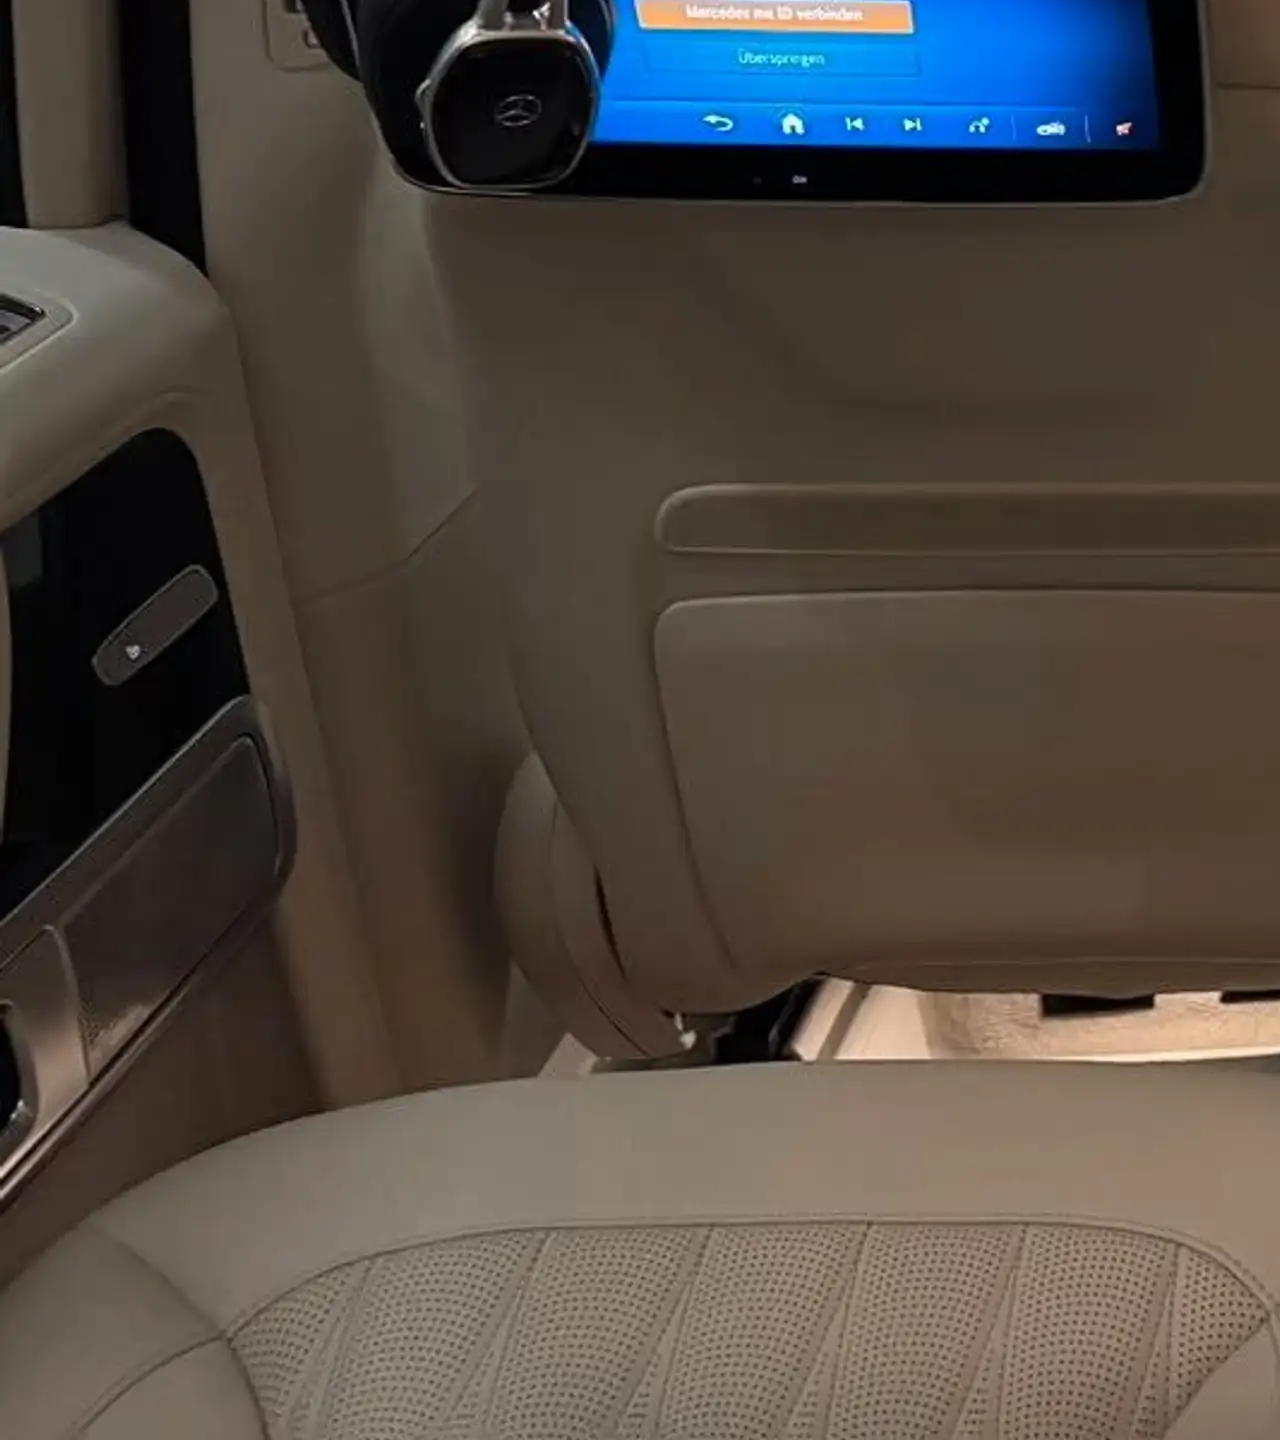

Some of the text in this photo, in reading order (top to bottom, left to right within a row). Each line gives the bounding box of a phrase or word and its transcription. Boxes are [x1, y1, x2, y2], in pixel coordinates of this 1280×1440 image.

[685, 3, 864, 22] Mercedes me ID verbinden
[737, 47, 826, 67] Überspringen
